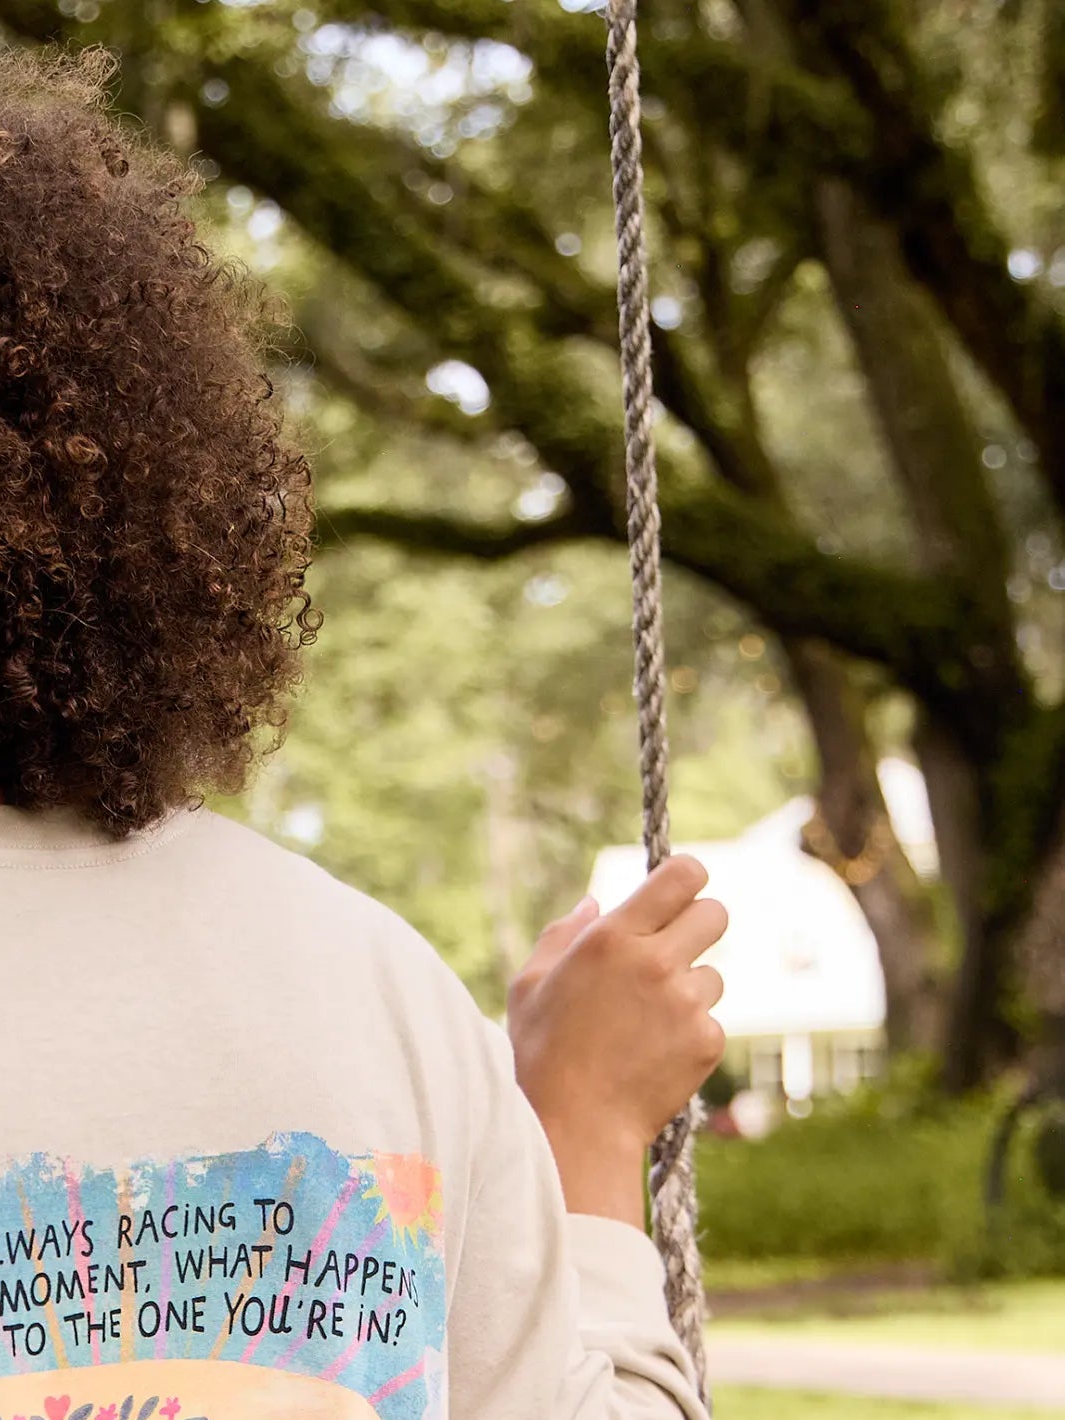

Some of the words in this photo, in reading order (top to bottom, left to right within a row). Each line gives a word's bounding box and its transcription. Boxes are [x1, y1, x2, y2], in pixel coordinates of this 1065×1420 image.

[253, 1198, 295, 1236] TO
[175, 1243, 273, 1283] WHAT
[2, 1322, 46, 1357] TO
[63, 1308, 122, 1346] THE
[137, 1296, 207, 1338] ONE
[224, 1291, 345, 1340] YOU'RE
